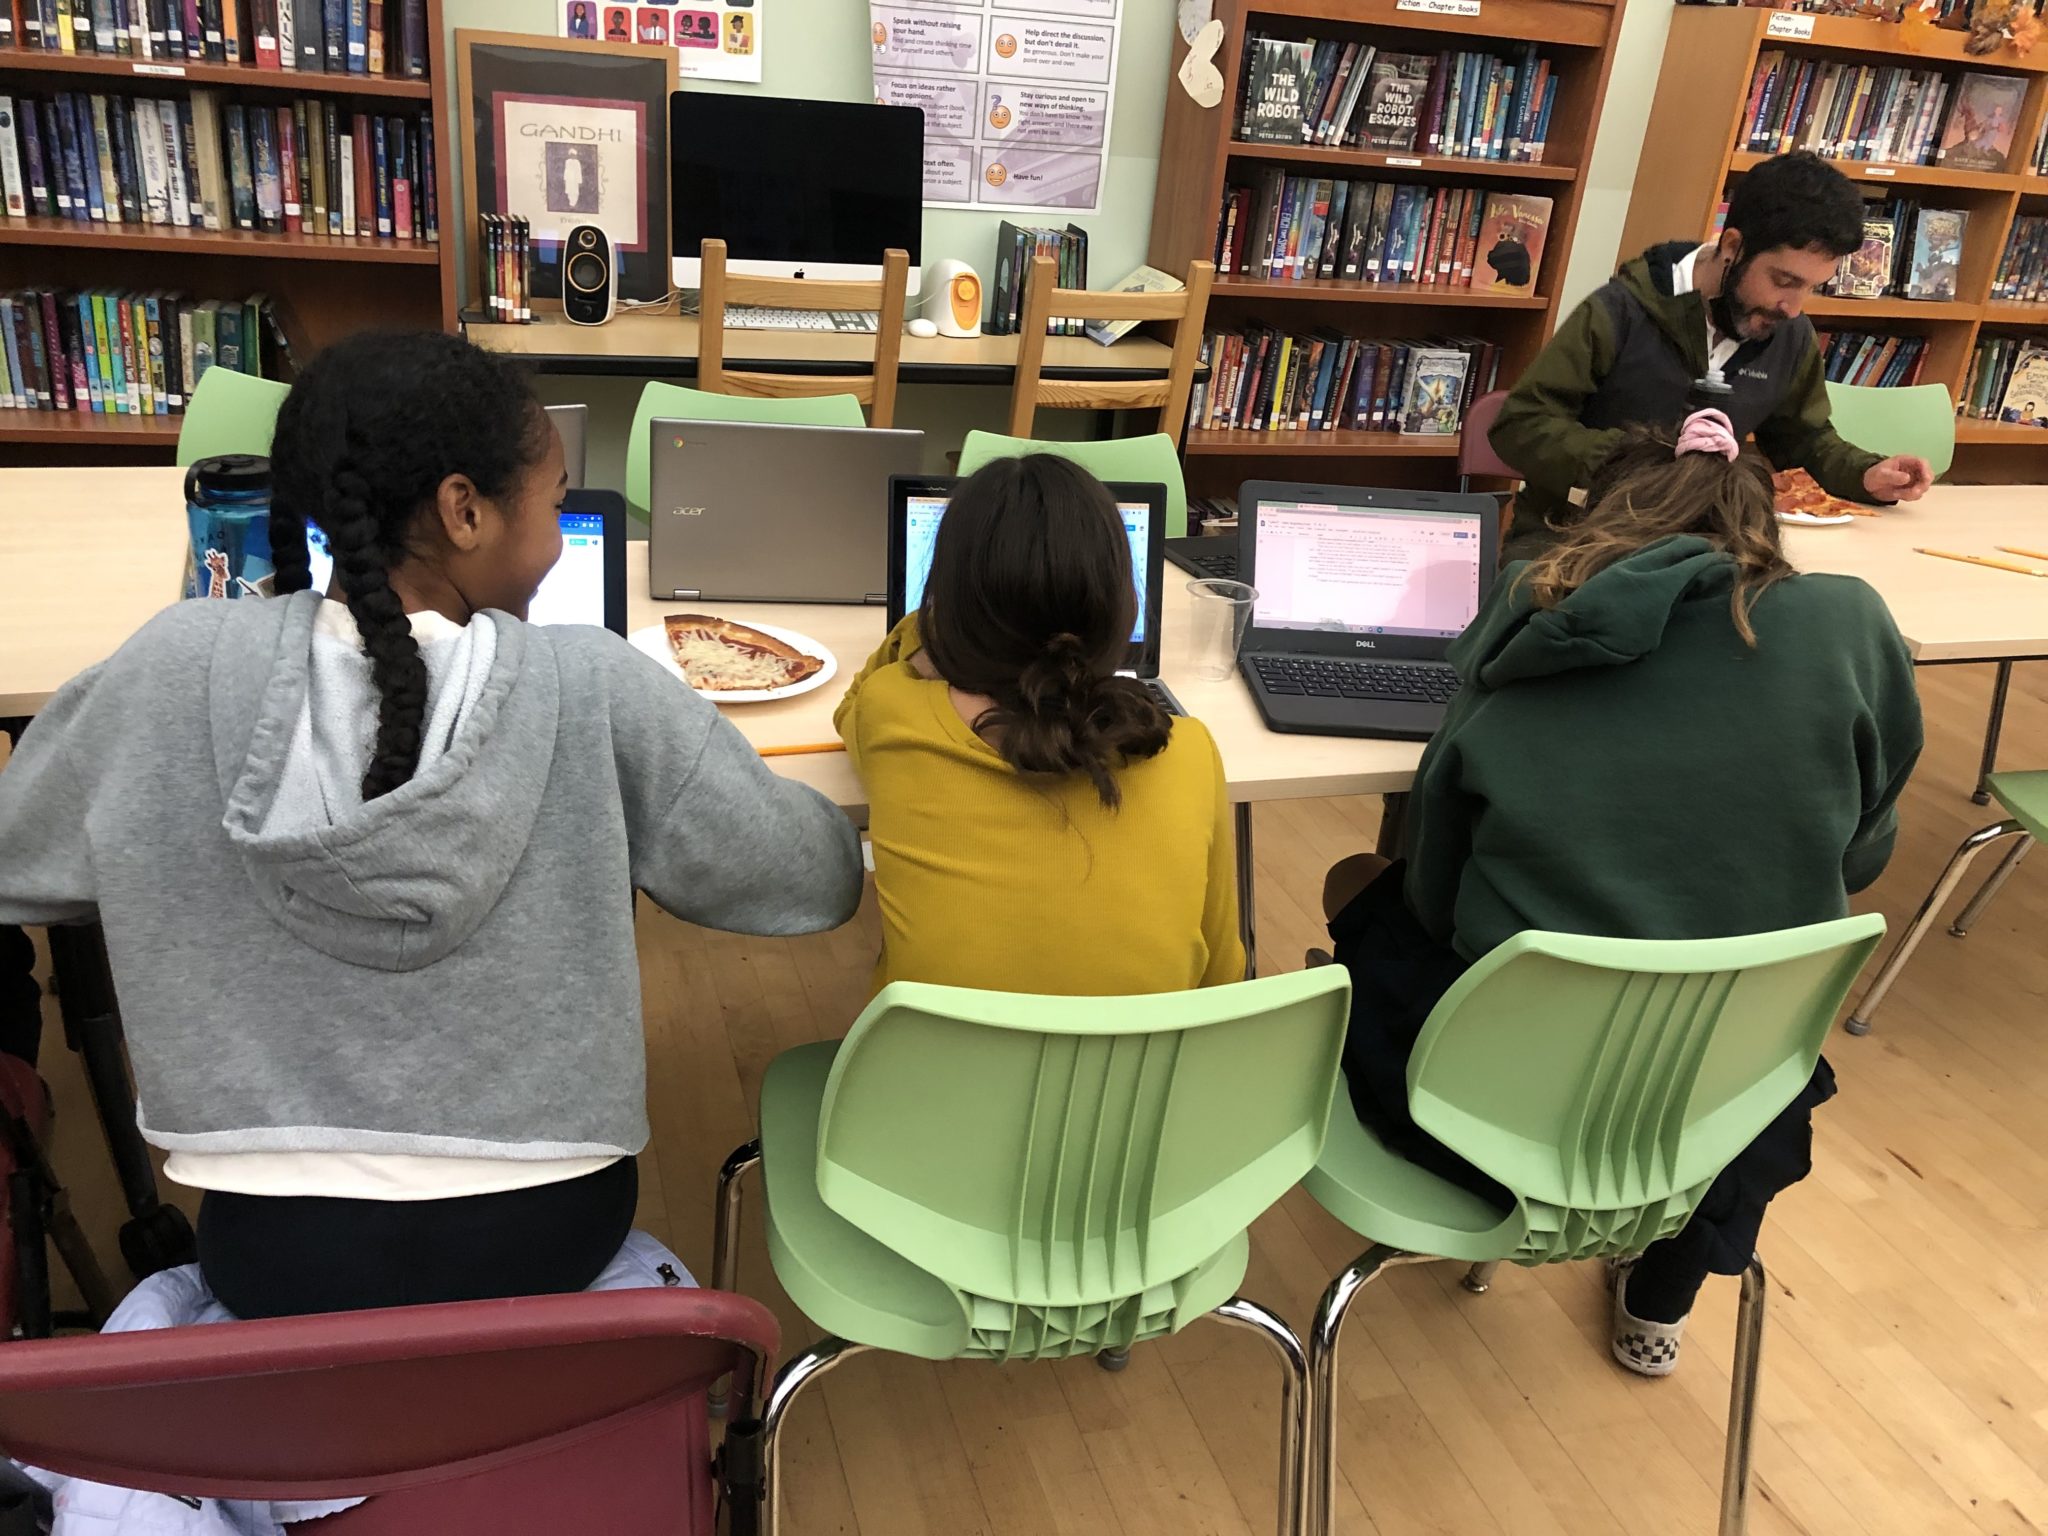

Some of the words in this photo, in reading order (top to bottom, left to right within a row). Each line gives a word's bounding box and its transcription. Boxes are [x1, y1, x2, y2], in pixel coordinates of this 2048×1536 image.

[1429, 2, 1455, 12] Chapter
[1458, 4, 1478, 13] Books
[893, 17, 911, 25] Speak
[940, 22, 961, 30] raising
[1794, 27, 1810, 36] Books
[1037, 39, 1053, 47] don't
[1272, 74, 1296, 86] THE
[918, 83, 934, 91] ideas
[1390, 83, 1410, 93] THE
[1035, 93, 1057, 101] curious
[1265, 88, 1299, 102] WILD
[1385, 93, 1413, 103] WILD
[1257, 103, 1301, 119] ROBOT
[1377, 103, 1414, 115] ROBOT
[1369, 114, 1416, 127] ESCAPES
[520, 123, 622, 142] GANDHI
[672, 506, 706, 515] acer
[1356, 640, 1376, 648] DELL
